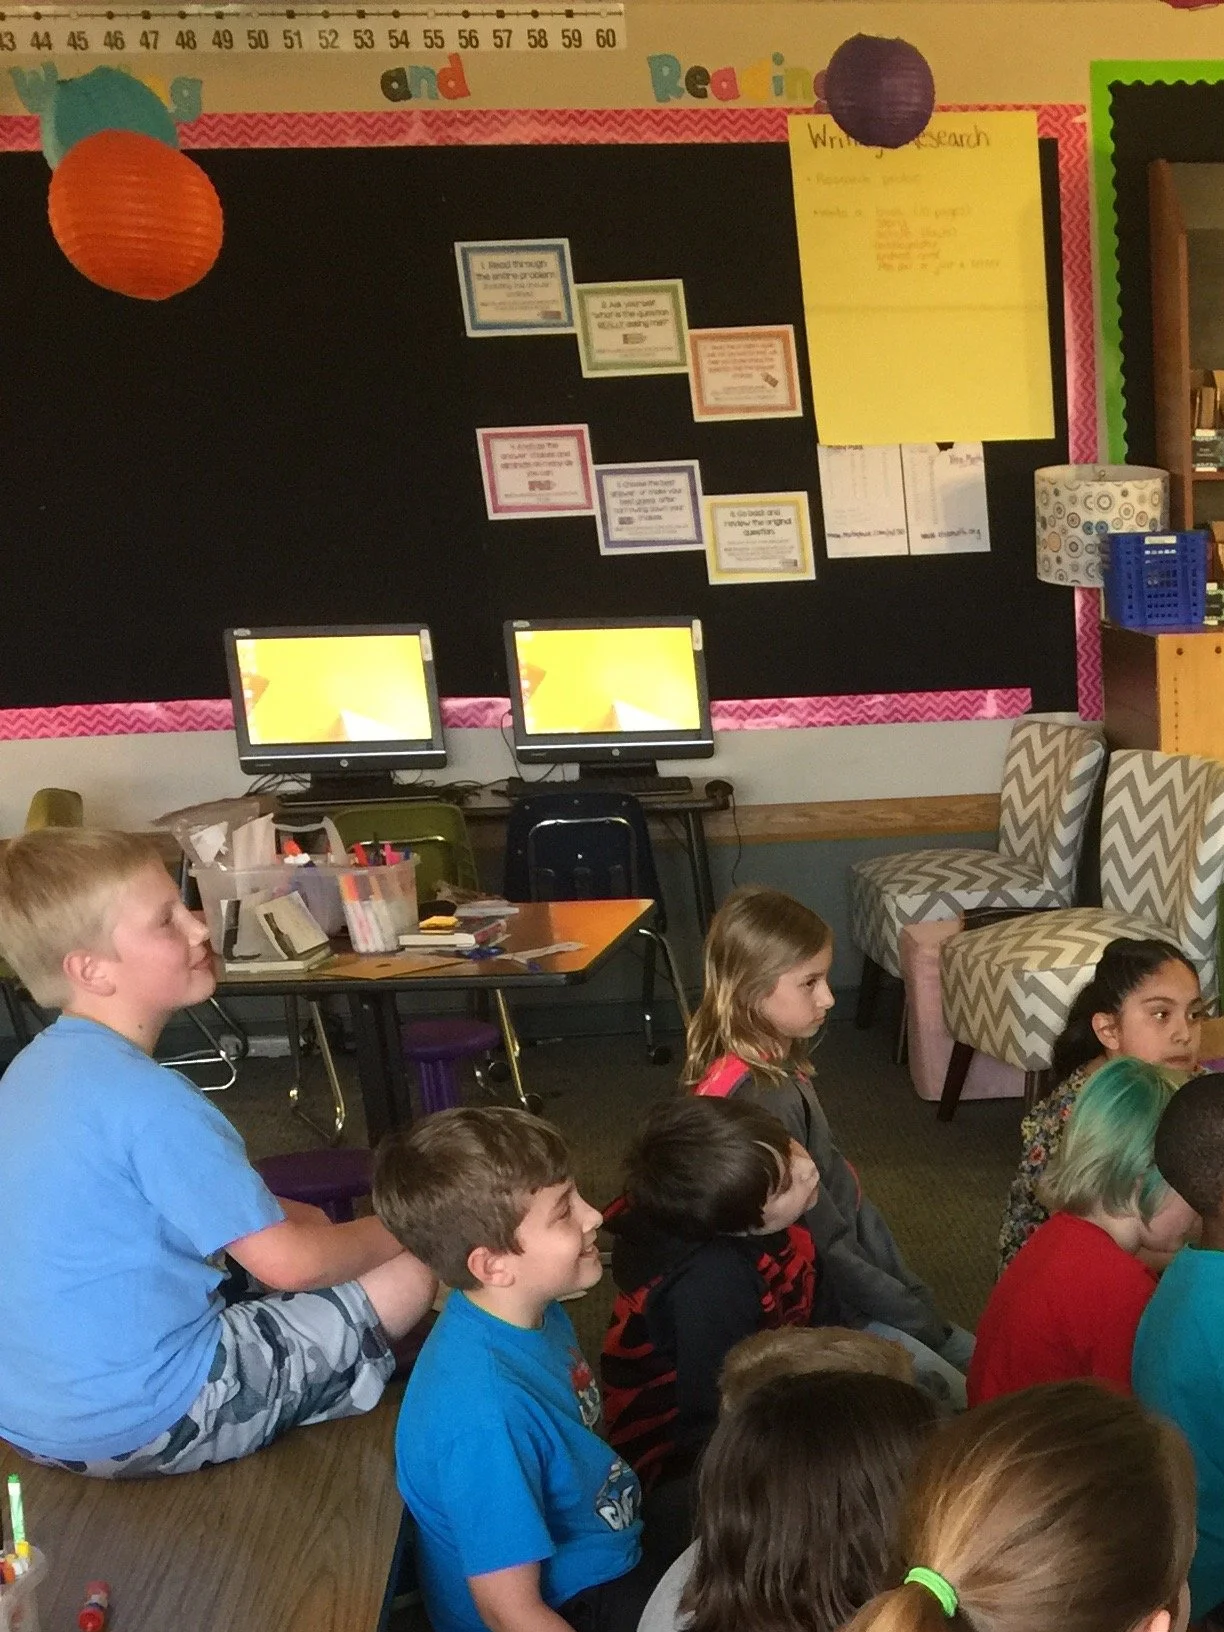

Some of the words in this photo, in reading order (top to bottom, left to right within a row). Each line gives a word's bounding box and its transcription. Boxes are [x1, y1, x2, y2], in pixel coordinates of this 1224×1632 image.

[30, 30, 52, 50] 44
[67, 30, 89, 50] 45
[104, 30, 125, 50] 46
[140, 30, 159, 50] 47
[176, 30, 197, 50] 48
[212, 30, 233, 50] 49
[249, 30, 270, 50] 50
[283, 30, 303, 50] 51
[318, 29, 339, 49] 52
[353, 29, 374, 49] 53
[388, 29, 410, 49] 54
[423, 29, 445, 49] 55
[458, 29, 479, 49] 56
[492, 29, 512, 49] 57
[527, 29, 548, 49] 58
[561, 29, 582, 49] 59
[596, 29, 616, 49] 60
[380, 52, 471, 102] and
